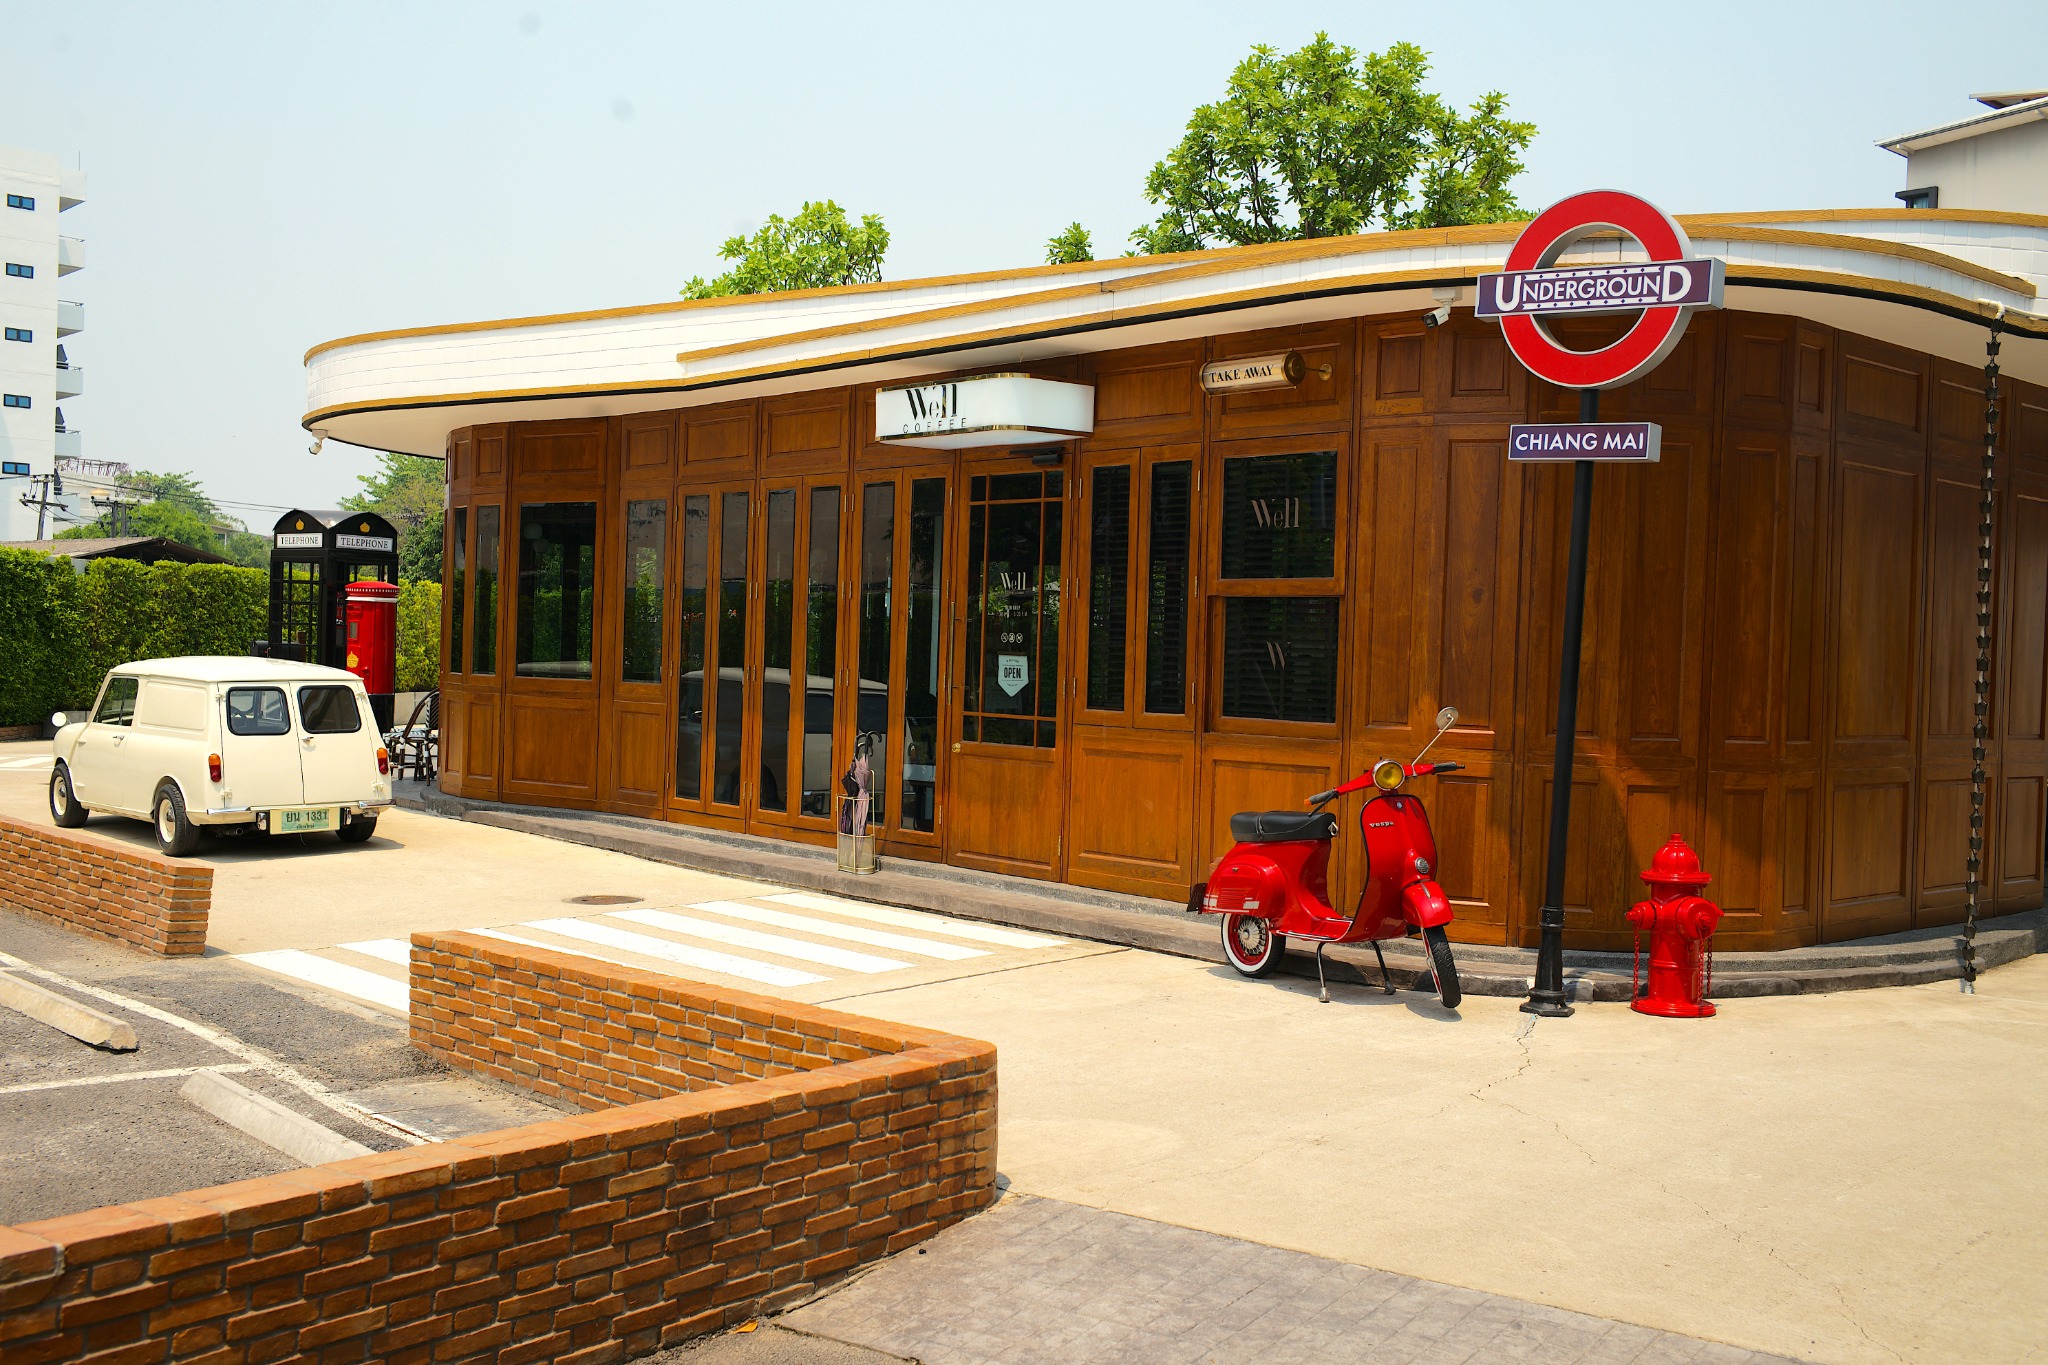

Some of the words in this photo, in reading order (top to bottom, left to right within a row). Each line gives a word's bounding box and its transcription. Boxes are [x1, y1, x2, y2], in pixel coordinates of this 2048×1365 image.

[1494, 265, 1692, 312] UNDERGROUND
[1208, 368, 1241, 383] TAKE
[1243, 364, 1274, 379] AWAY
[905, 383, 958, 420] Well
[902, 417, 967, 434] COFFEE
[1514, 431, 1598, 452] CHIANG
[1603, 431, 1645, 451] MAI
[1251, 497, 1300, 529] Well
[280, 536, 319, 546] TELEPHONE
[340, 537, 389, 549] TELEPHONE
[1000, 571, 1027, 590] Well
[1003, 666, 1022, 679] OPEN
[305, 810, 328, 822] 1331
